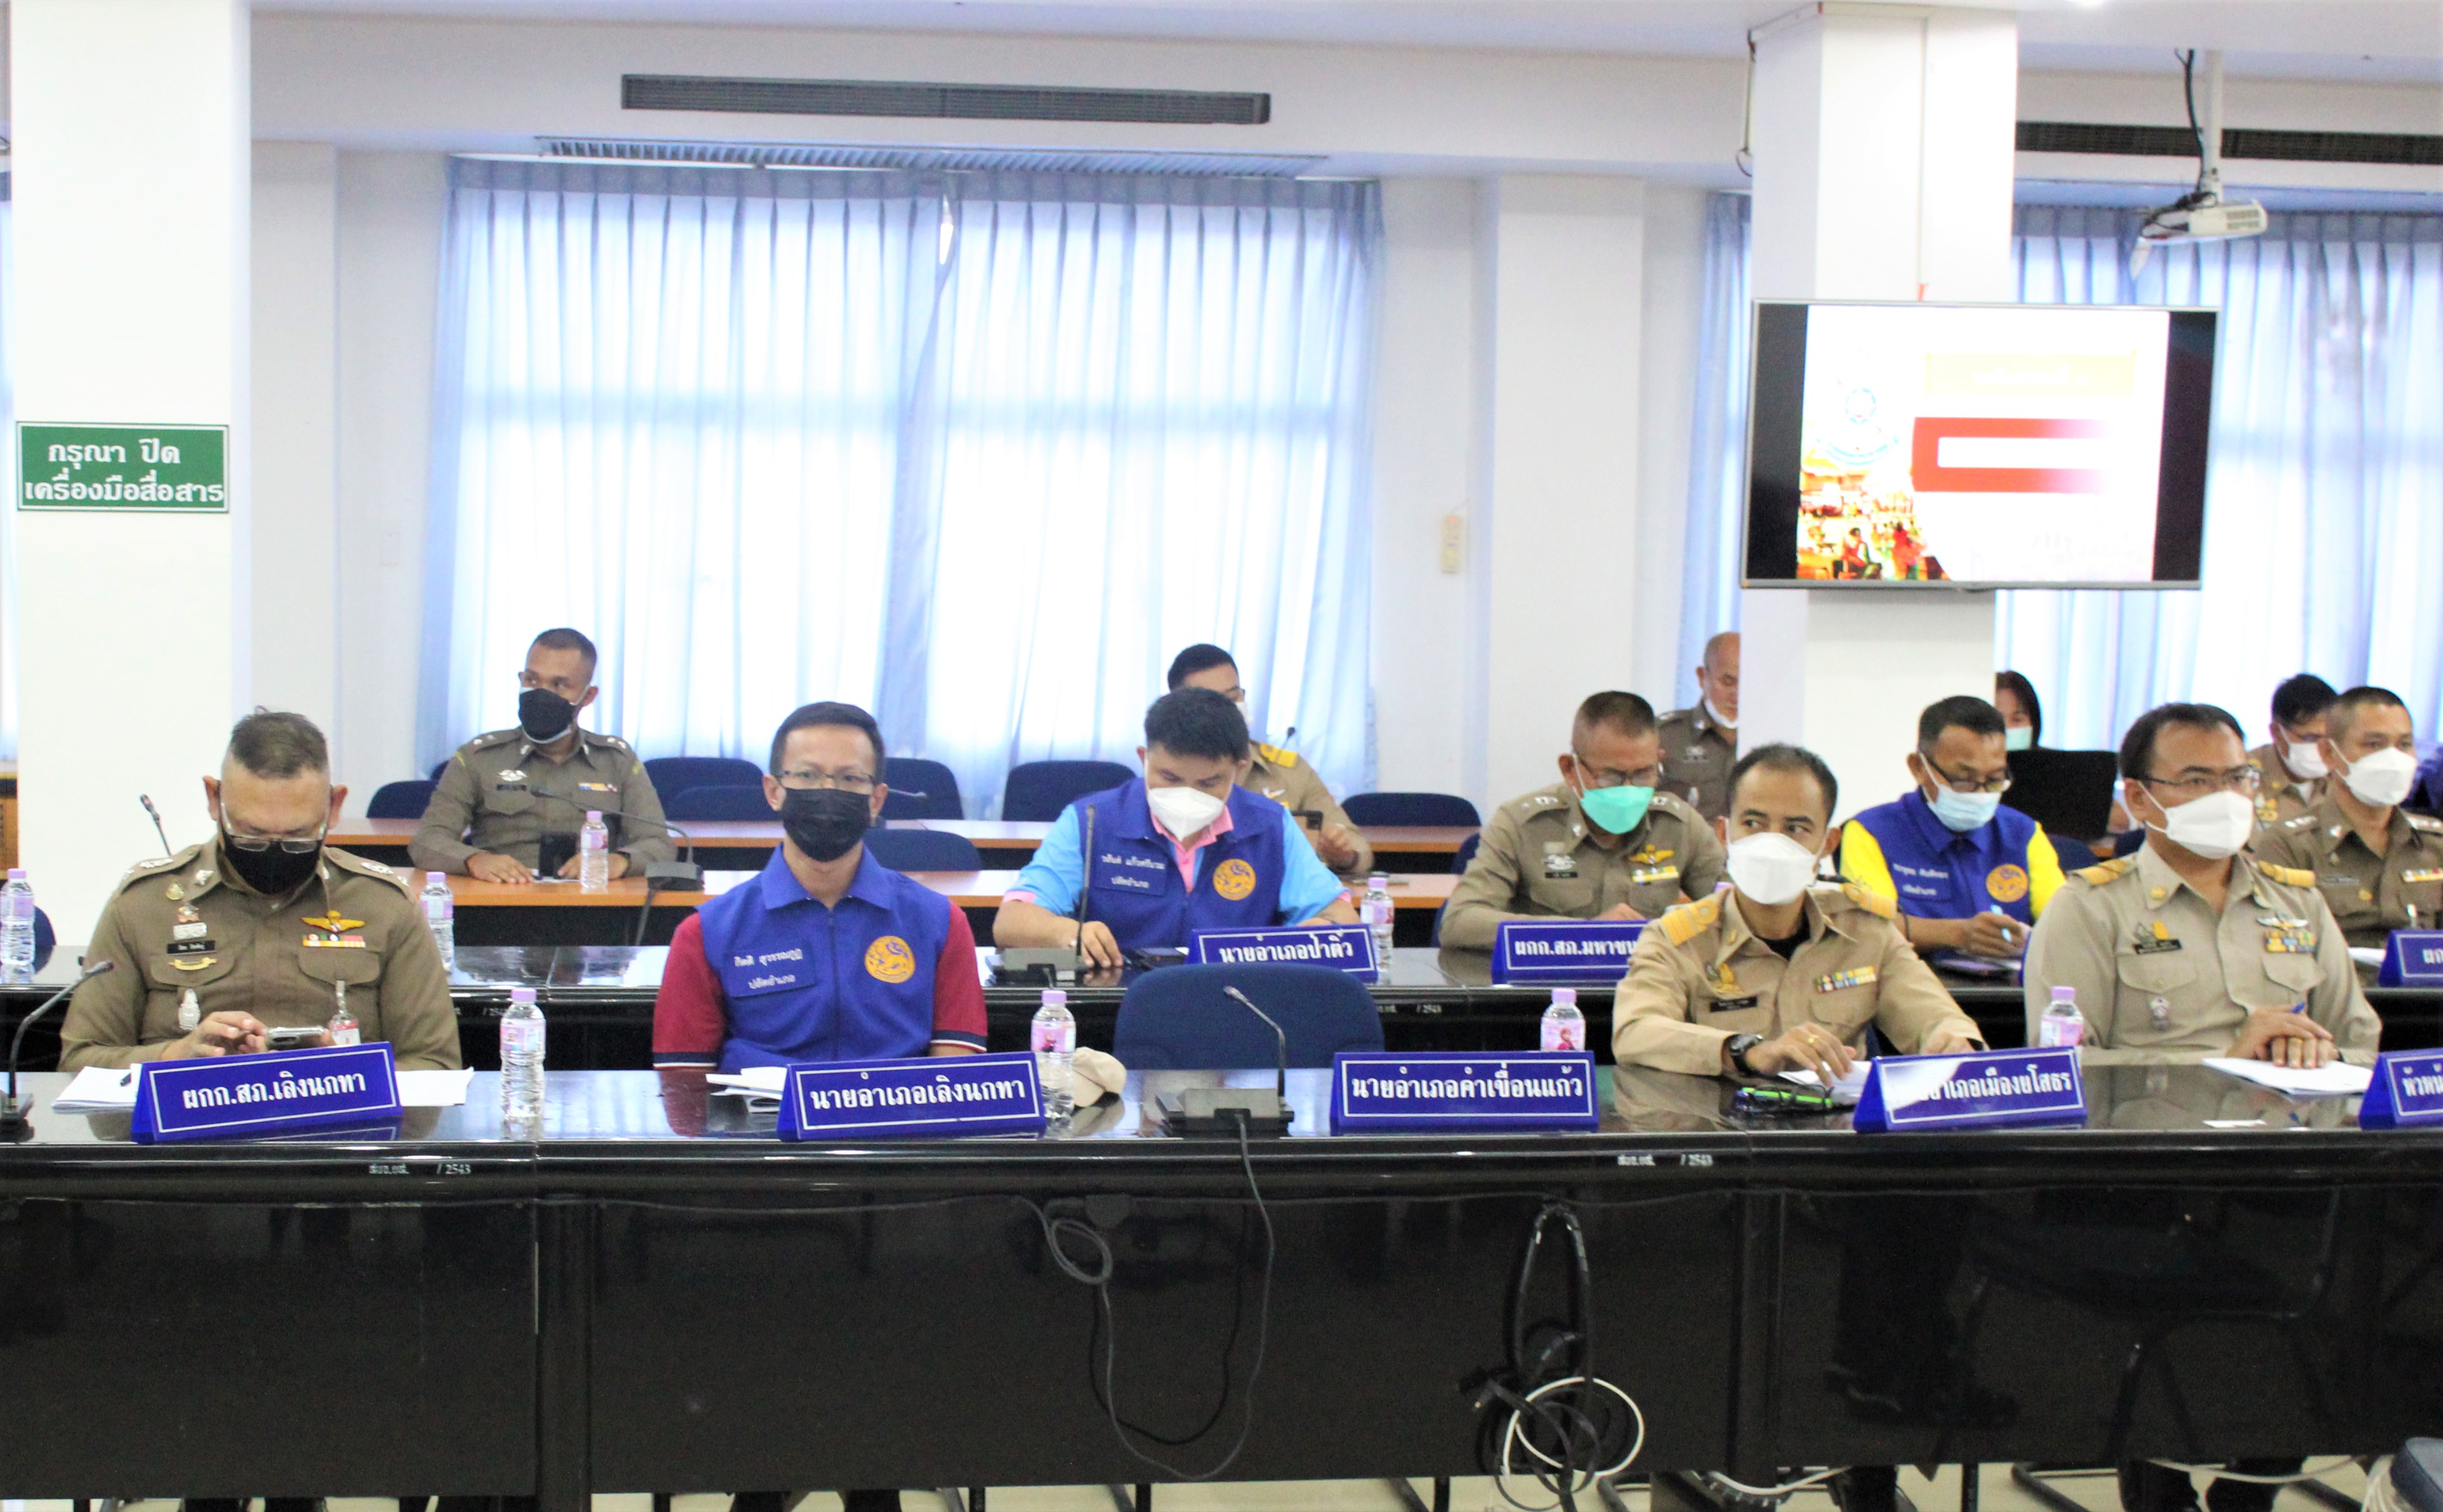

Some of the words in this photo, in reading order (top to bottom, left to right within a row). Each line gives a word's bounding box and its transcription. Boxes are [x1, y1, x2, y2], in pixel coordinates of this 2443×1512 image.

[48, 443, 126, 470] กรุณา
[138, 437, 181, 464] ปิด
[25, 467, 224, 503] เครื่องมือสื่อสาร
[182, 1070, 367, 1109] ผกก.สภ.เลิงนกทา
[809, 1071, 1026, 1110] นายอำเภอเลิงนกทา
[1351, 1062, 1583, 1099] นายอำเภอคำเขื่อนแก้ว
[1921, 1064, 2073, 1101] อำเภอเมืองยโสธร
